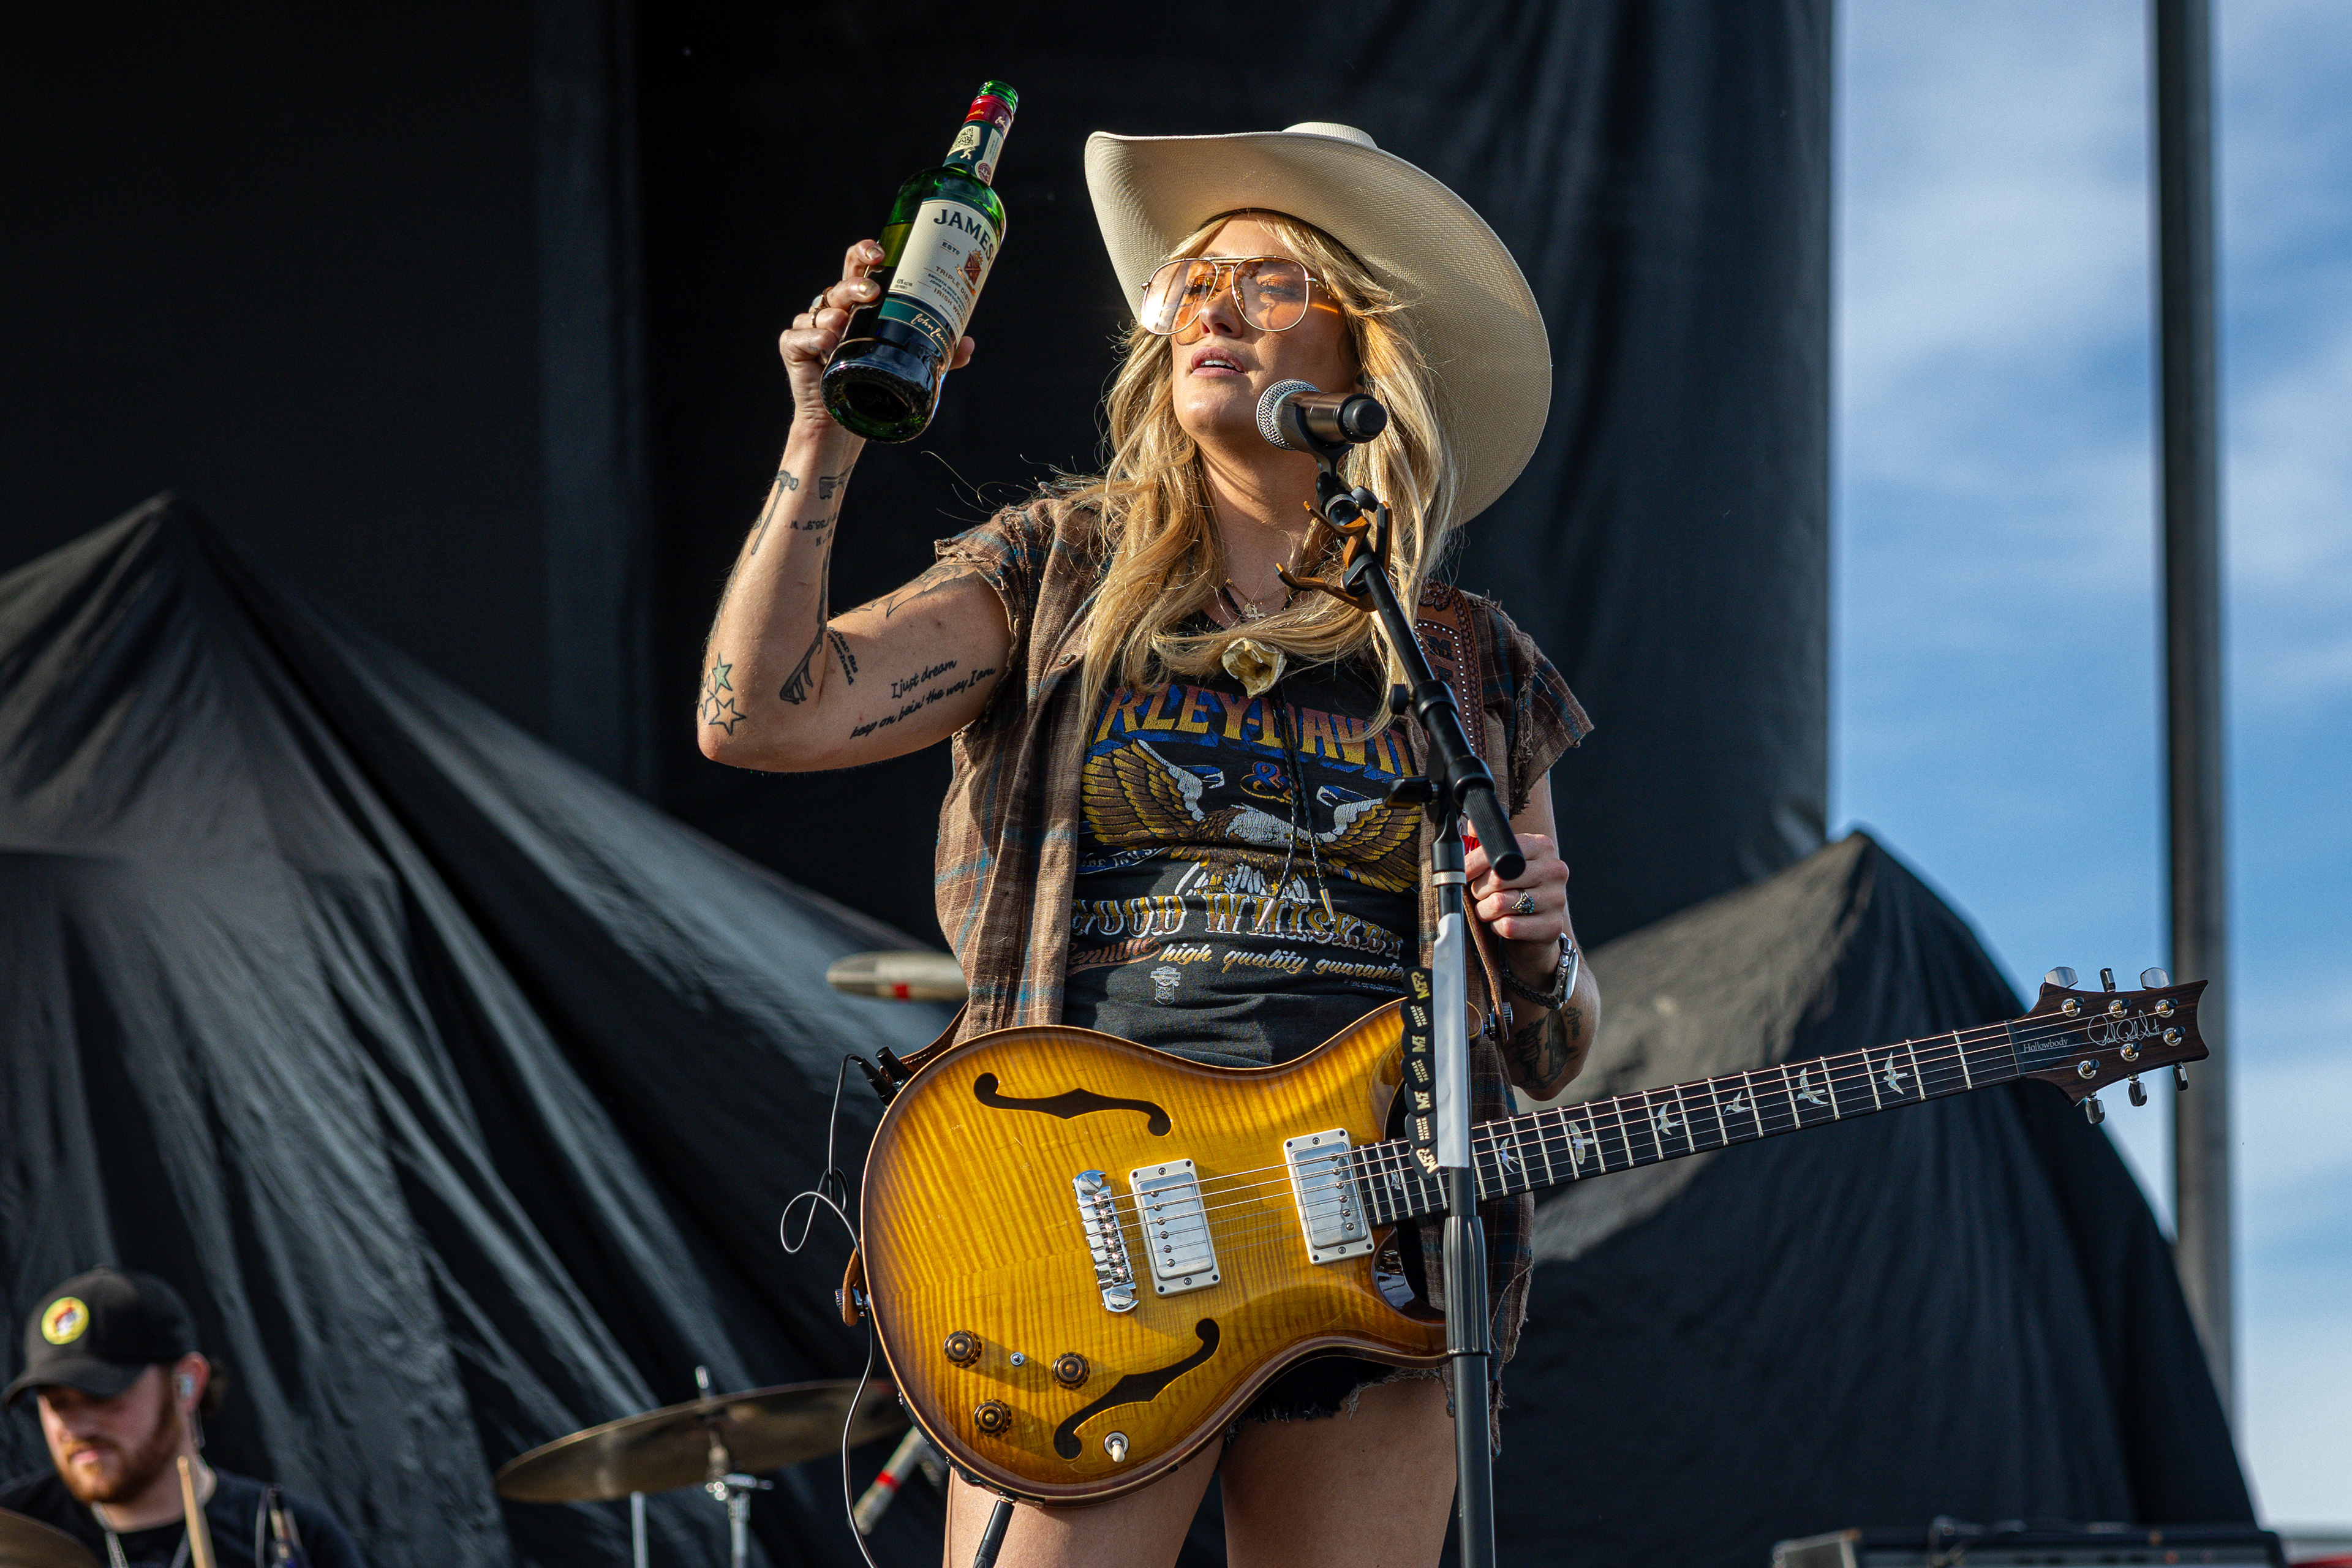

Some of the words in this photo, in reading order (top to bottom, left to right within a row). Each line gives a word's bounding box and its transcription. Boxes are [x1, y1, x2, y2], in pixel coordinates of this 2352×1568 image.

[933, 208, 995, 263] JAMES
[927, 273, 947, 287] SMOOTH
[929, 279, 943, 289] JOHN
[935, 266, 960, 288] TRIPLE
[933, 288, 953, 305] IRISH
[911, 313, 933, 331] John
[891, 682, 898, 699] I
[897, 673, 919, 699] just
[921, 660, 957, 683] dream
[850, 721, 878, 740] keep
[879, 714, 897, 728] on
[926, 688, 944, 704] the
[946, 678, 968, 696] way
[968, 669, 978, 688] I
[976, 668, 997, 682] am
[1071, 895, 1188, 938] GOOD
[1201, 893, 1404, 960] WHISKEY
[1158, 943, 1213, 965] high
[1222, 948, 1309, 974] quality
[1312, 958, 1404, 981] guarante
[1410, 1005, 1423, 1027] MEGHAN
[1416, 1005, 1428, 1026] PATRIC
[2022, 1036, 2068, 1053] Hollowbody
[1411, 1061, 1424, 1084] MEGHAN
[1416, 1058, 1430, 1082] PATRICK
[1415, 1118, 1425, 1141] MEGHAN
[1421, 1117, 1430, 1140] PATRICK
